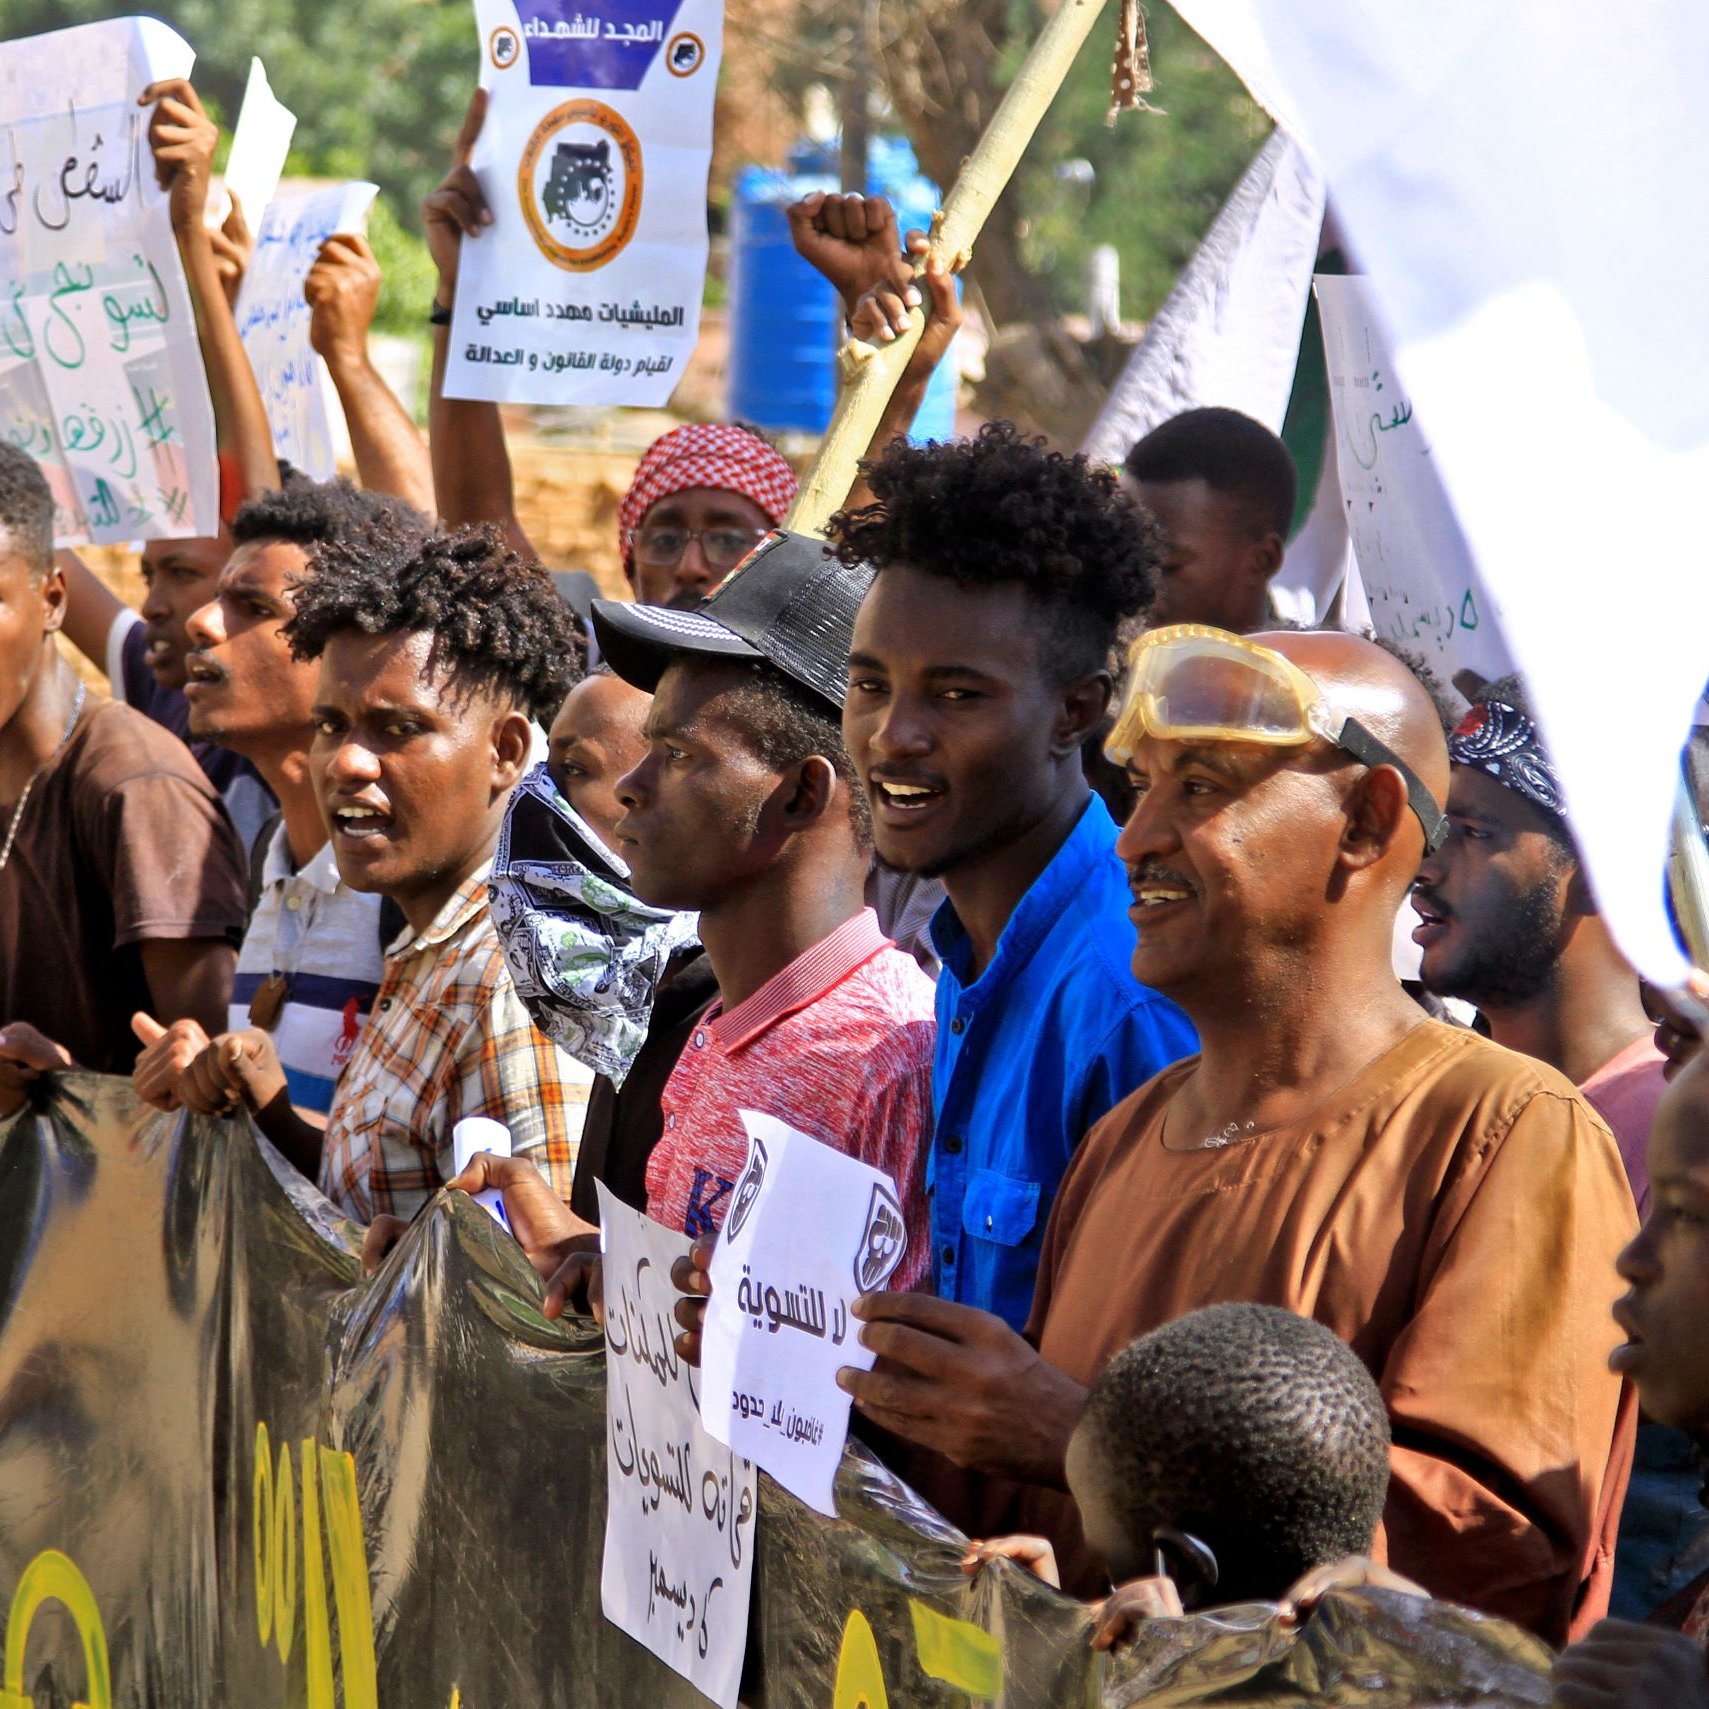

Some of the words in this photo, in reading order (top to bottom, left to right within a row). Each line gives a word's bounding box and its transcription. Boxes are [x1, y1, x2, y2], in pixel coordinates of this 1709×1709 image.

[523, 12, 600, 39] للشهداء
[604, 19, 664, 47] المجد
[477, 297, 541, 326] اساسي
[546, 302, 594, 322] مهدد
[598, 300, 684, 330] المليشيات
[464, 343, 525, 366] العدالة
[528, 351, 539, 371] و
[542, 350, 597, 373] القانون
[599, 351, 632, 376] دولة
[632, 355, 673, 377] لقيام
[737, 1262, 828, 1340] للتسوية
[832, 1297, 849, 1347] لا
